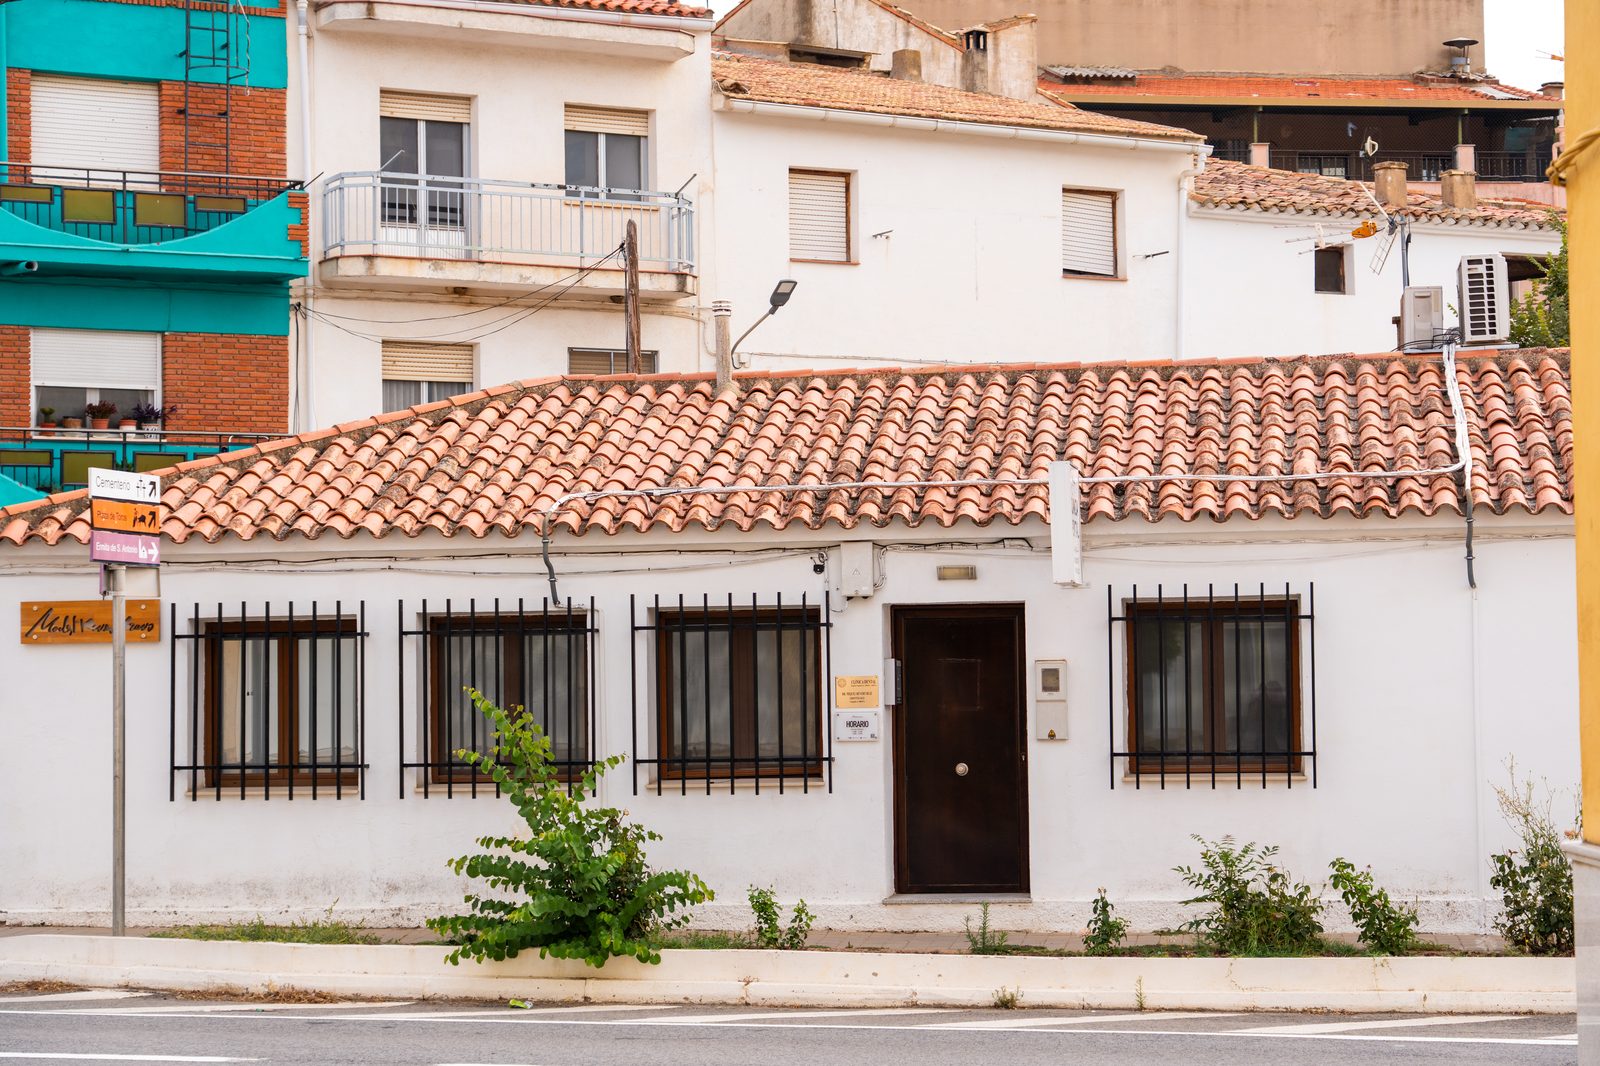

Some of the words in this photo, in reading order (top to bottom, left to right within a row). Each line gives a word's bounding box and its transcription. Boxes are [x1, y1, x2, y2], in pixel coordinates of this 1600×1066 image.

[96, 476, 130, 490] Cementerio
[110, 512, 115, 520] de
[96, 542, 110, 551] Ermita
[110, 543, 117, 551] de
